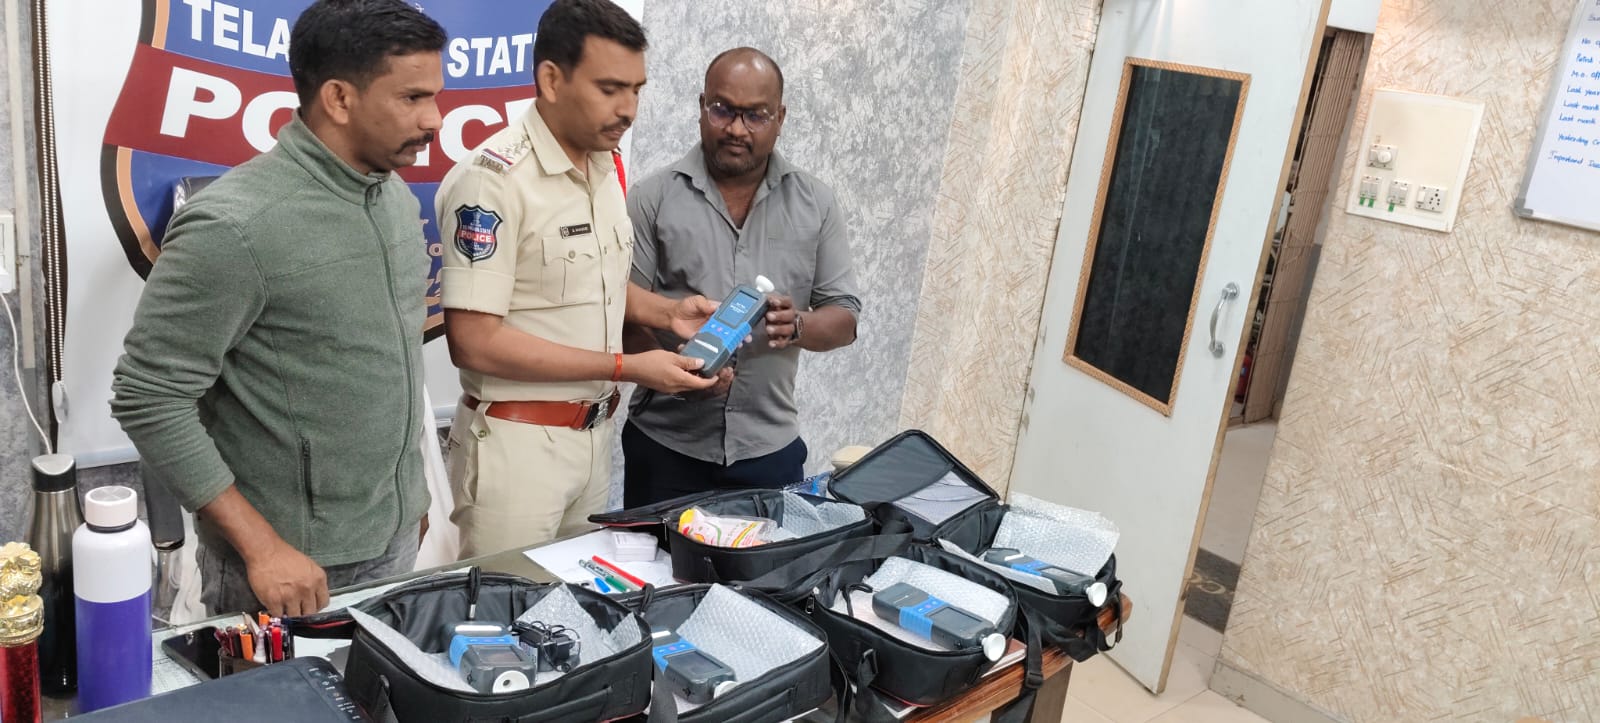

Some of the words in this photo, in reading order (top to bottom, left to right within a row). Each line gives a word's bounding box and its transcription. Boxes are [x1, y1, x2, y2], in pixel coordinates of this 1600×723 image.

[182, 0, 291, 62] TELA
[447, 33, 537, 78] STAT
[460, 230, 493, 243] POLICE
